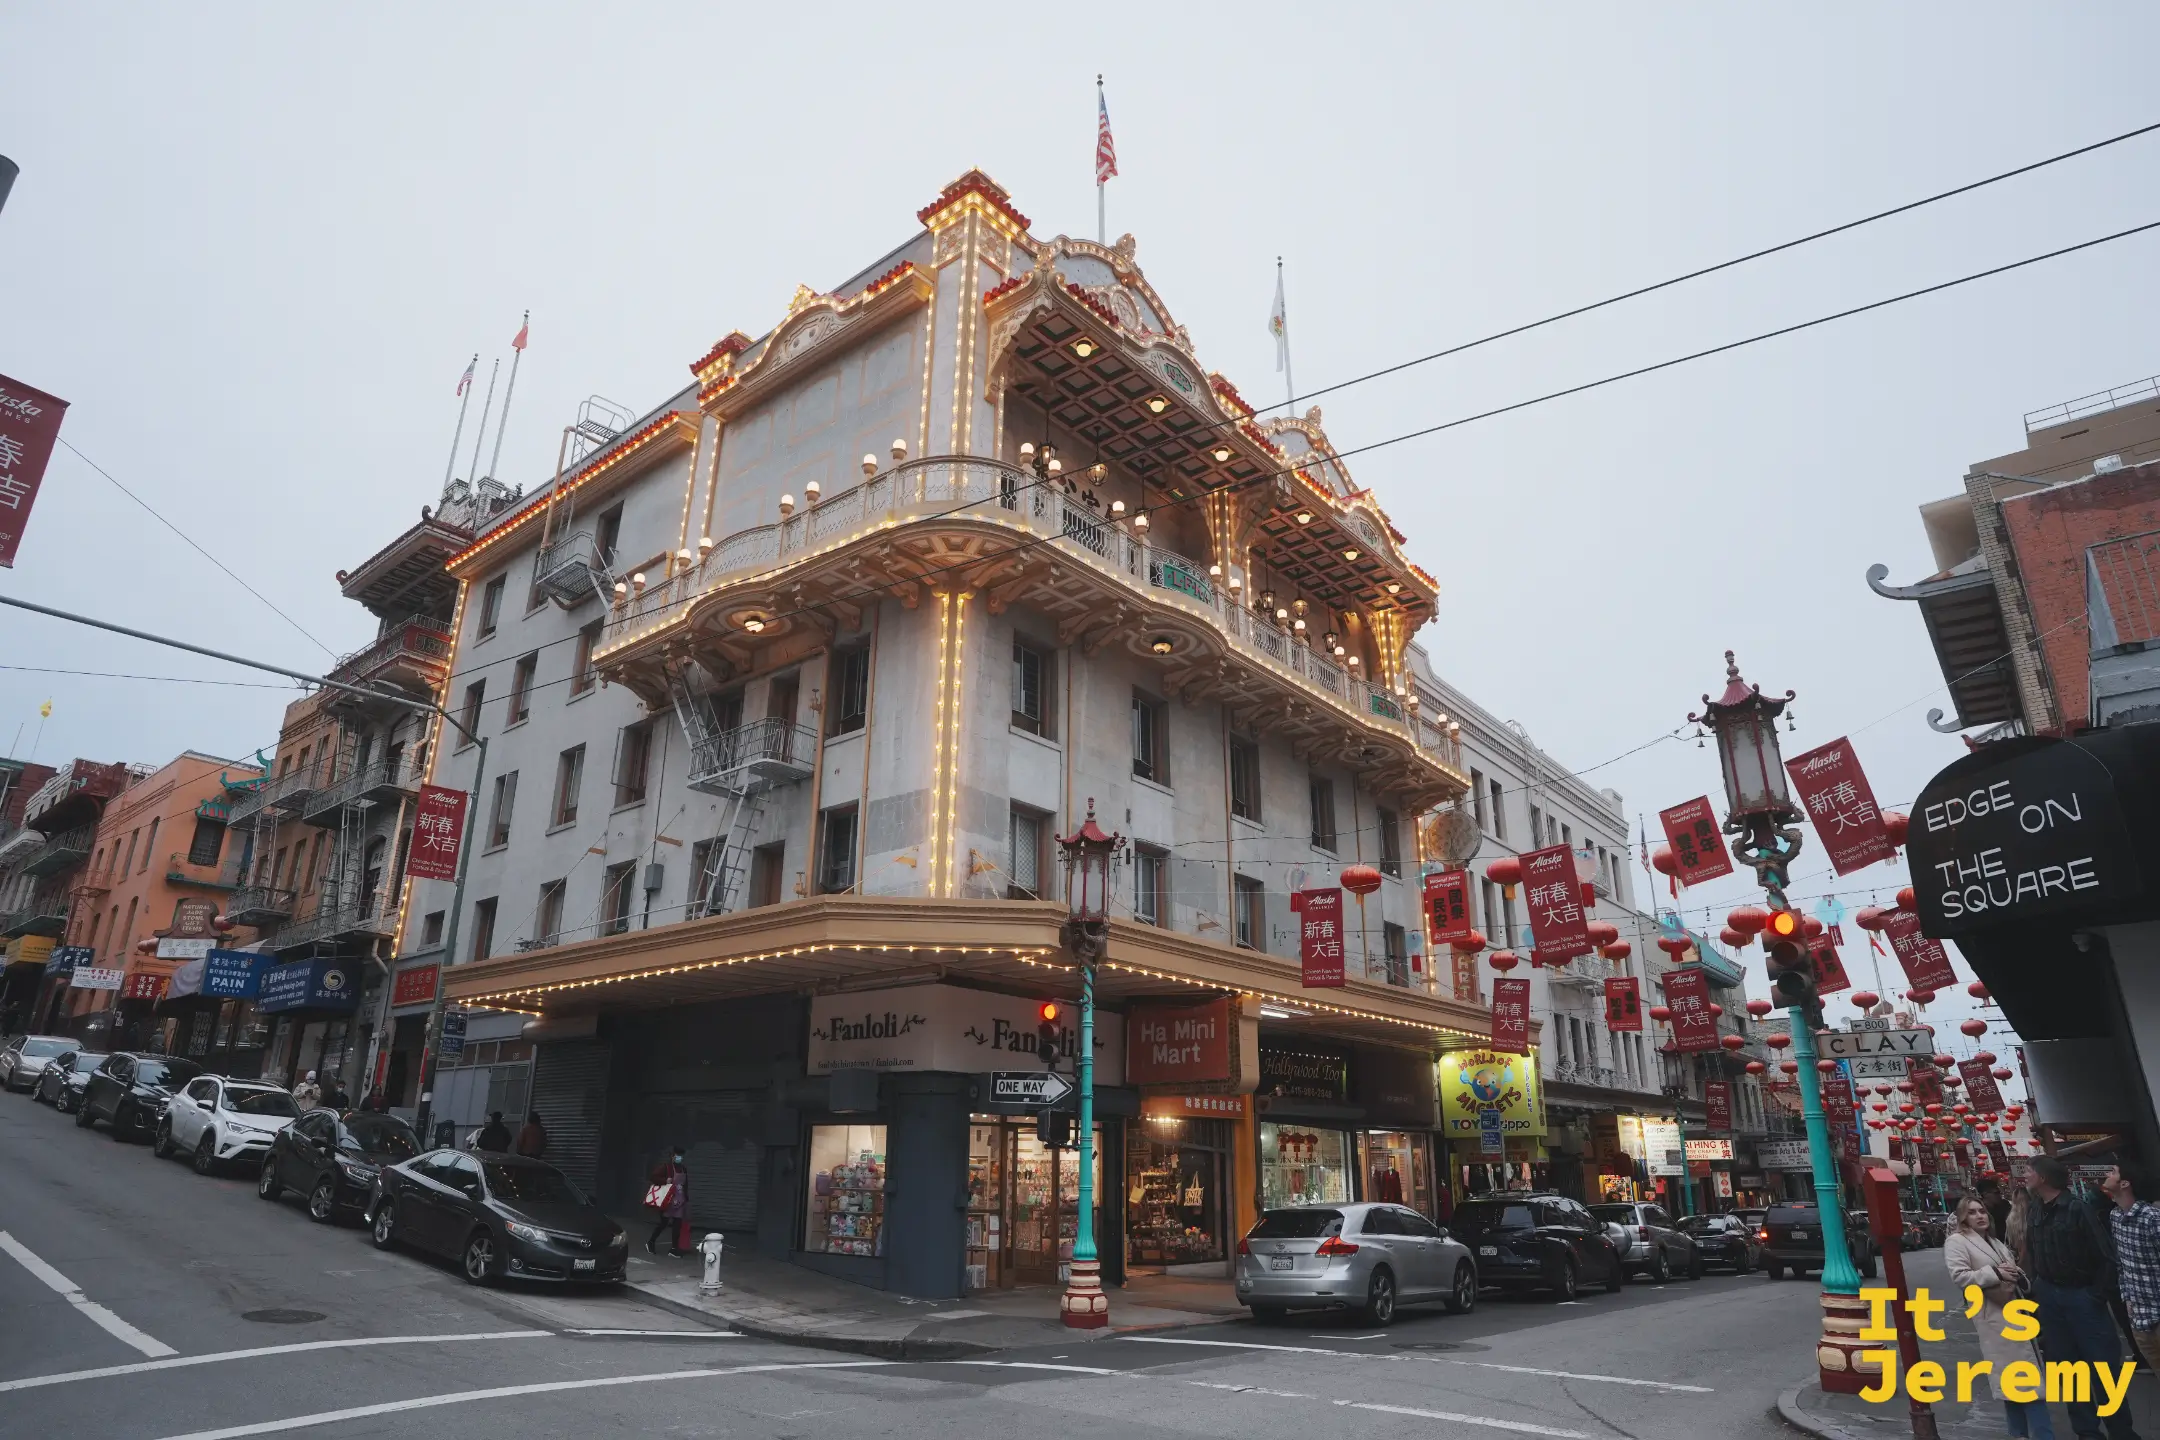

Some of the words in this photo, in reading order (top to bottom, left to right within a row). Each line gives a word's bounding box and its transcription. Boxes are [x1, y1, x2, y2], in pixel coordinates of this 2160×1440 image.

[0, 387, 42, 417] aska
[1801, 751, 1841, 774] Alaska
[1807, 762, 1843, 779] AIRLINES
[429, 792, 459, 805] Alaska
[1808, 780, 1858, 815] 新春
[1925, 780, 2015, 832] EDGE
[1830, 800, 1877, 835] 大吉
[2019, 792, 2082, 833] ON
[418, 812, 454, 834] 新春
[422, 832, 458, 853] 大吉
[1834, 845, 1859, 859] Chinese
[1859, 837, 1874, 848] New
[1529, 853, 1563, 870] Alaska
[1840, 852, 1864, 865] Festival
[1869, 842, 1889, 852] Parade
[1935, 847, 2006, 888] THE
[1529, 881, 1569, 907] 新春
[1941, 857, 2099, 918] SQUARE
[1308, 894, 1335, 906] Alaska
[1542, 901, 1580, 928] 大吉
[1889, 912, 1916, 924] Alask
[1304, 920, 1335, 939] 新春
[1311, 940, 1341, 958] 大吉
[1894, 930, 1928, 953] 新春
[1910, 945, 1943, 968] 大吉
[211, 977, 245, 989] PAIN
[1500, 982, 1524, 991] Alaska
[1670, 974, 1697, 985] Alaska
[1495, 1002, 1522, 1016] 新春
[1671, 995, 1702, 1012] 新春
[829, 1012, 898, 1041] Fanloli
[1499, 1017, 1526, 1032] 大吉
[1681, 1011, 1710, 1028] 大吉
[1864, 1020, 1884, 1030] 800
[991, 1018, 1074, 1057] Fanli
[1141, 1022, 1168, 1042] Ha
[1174, 1018, 1215, 1041] Mini
[1152, 1042, 1201, 1065] Mart
[1830, 1034, 1918, 1054] CLAY
[875, 1058, 914, 1067] fanloli.com
[1264, 1056, 1320, 1083] Hollywood
[1323, 1065, 1340, 1081] Too
[1458, 1053, 1496, 1071] WORLD
[1856, 1060, 1901, 1073] 企李街
[998, 1082, 1019, 1093] ONE
[1023, 1082, 1045, 1093] WAY
[1974, 1086, 1997, 1098] 大吉
[1711, 1106, 1728, 1115] 大吉
[1834, 1106, 1853, 1116] 大吉
[1694, 1141, 1717, 1149] HING
